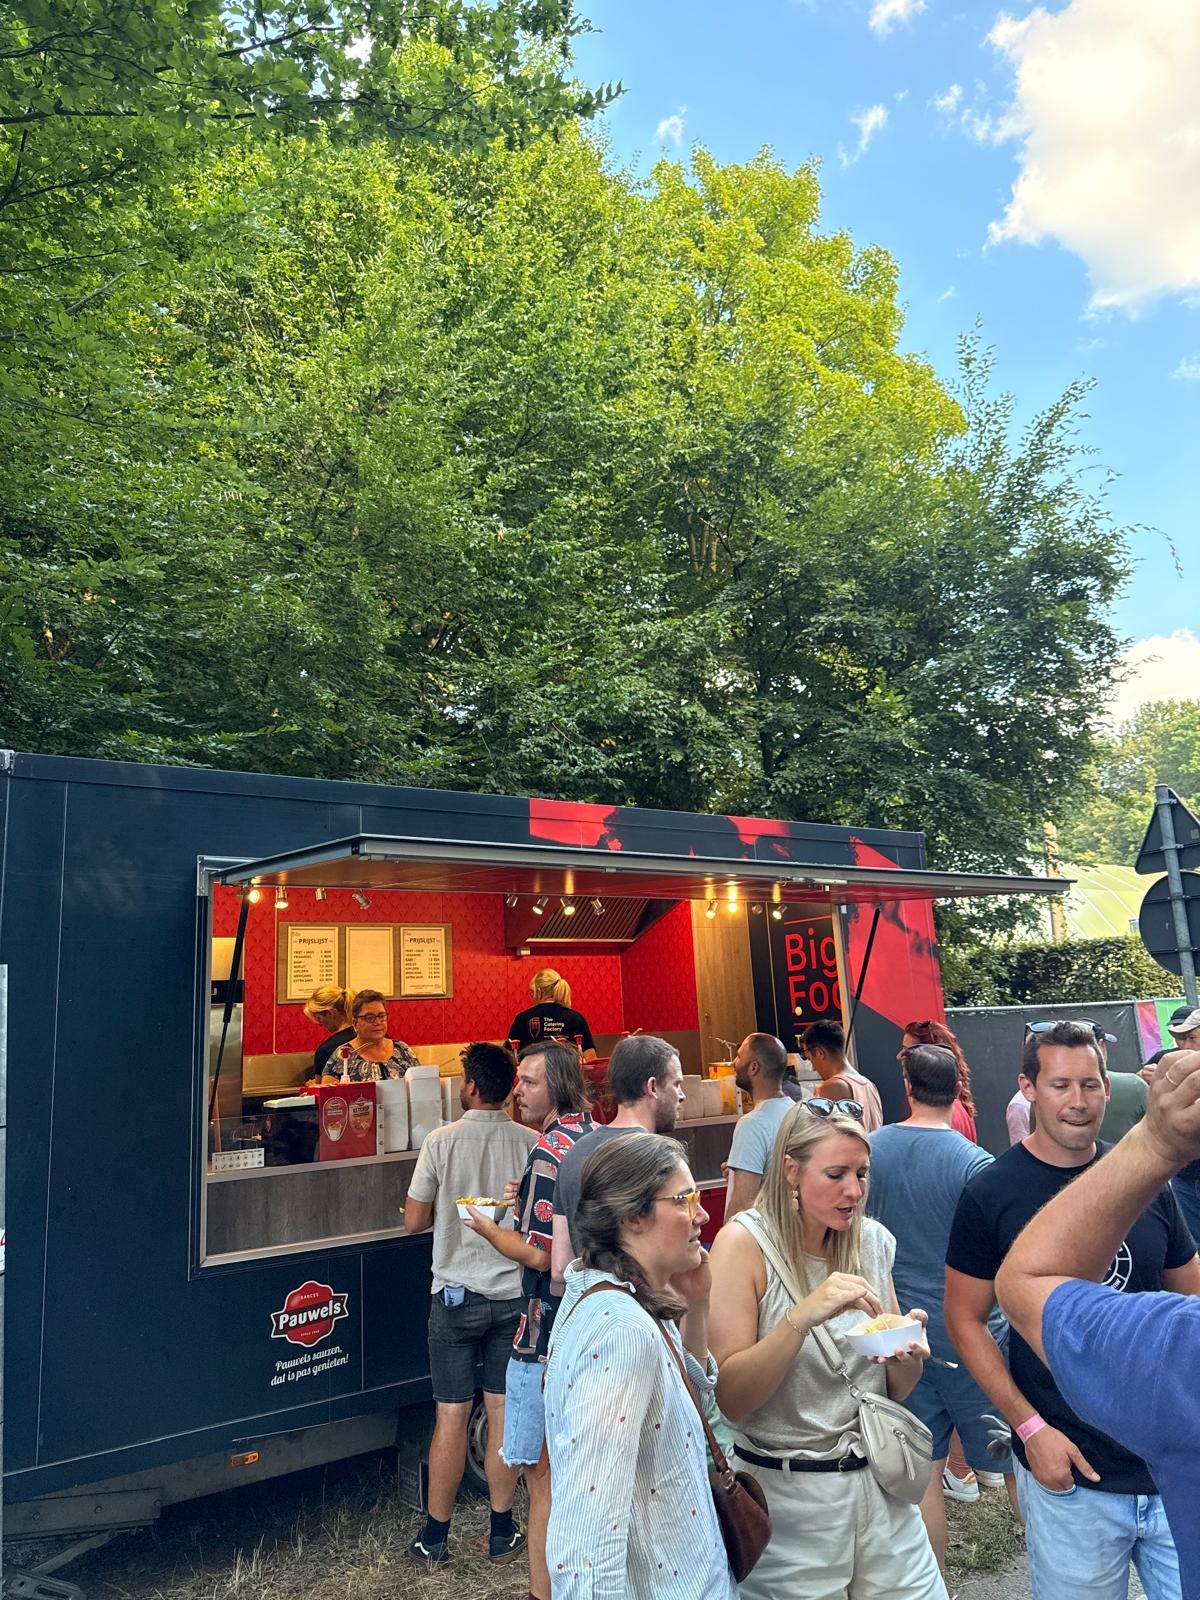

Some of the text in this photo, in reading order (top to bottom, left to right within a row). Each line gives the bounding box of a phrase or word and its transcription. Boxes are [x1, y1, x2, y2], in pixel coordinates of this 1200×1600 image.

[298, 937, 329, 945] PRIJSLIJST
[785, 927, 838, 978] Big
[279, 1299, 342, 1330] Pauwels
[270, 1353, 349, 1386] dat is pas genieten!
[275, 1346, 343, 1372] Pauwels sauzen,
